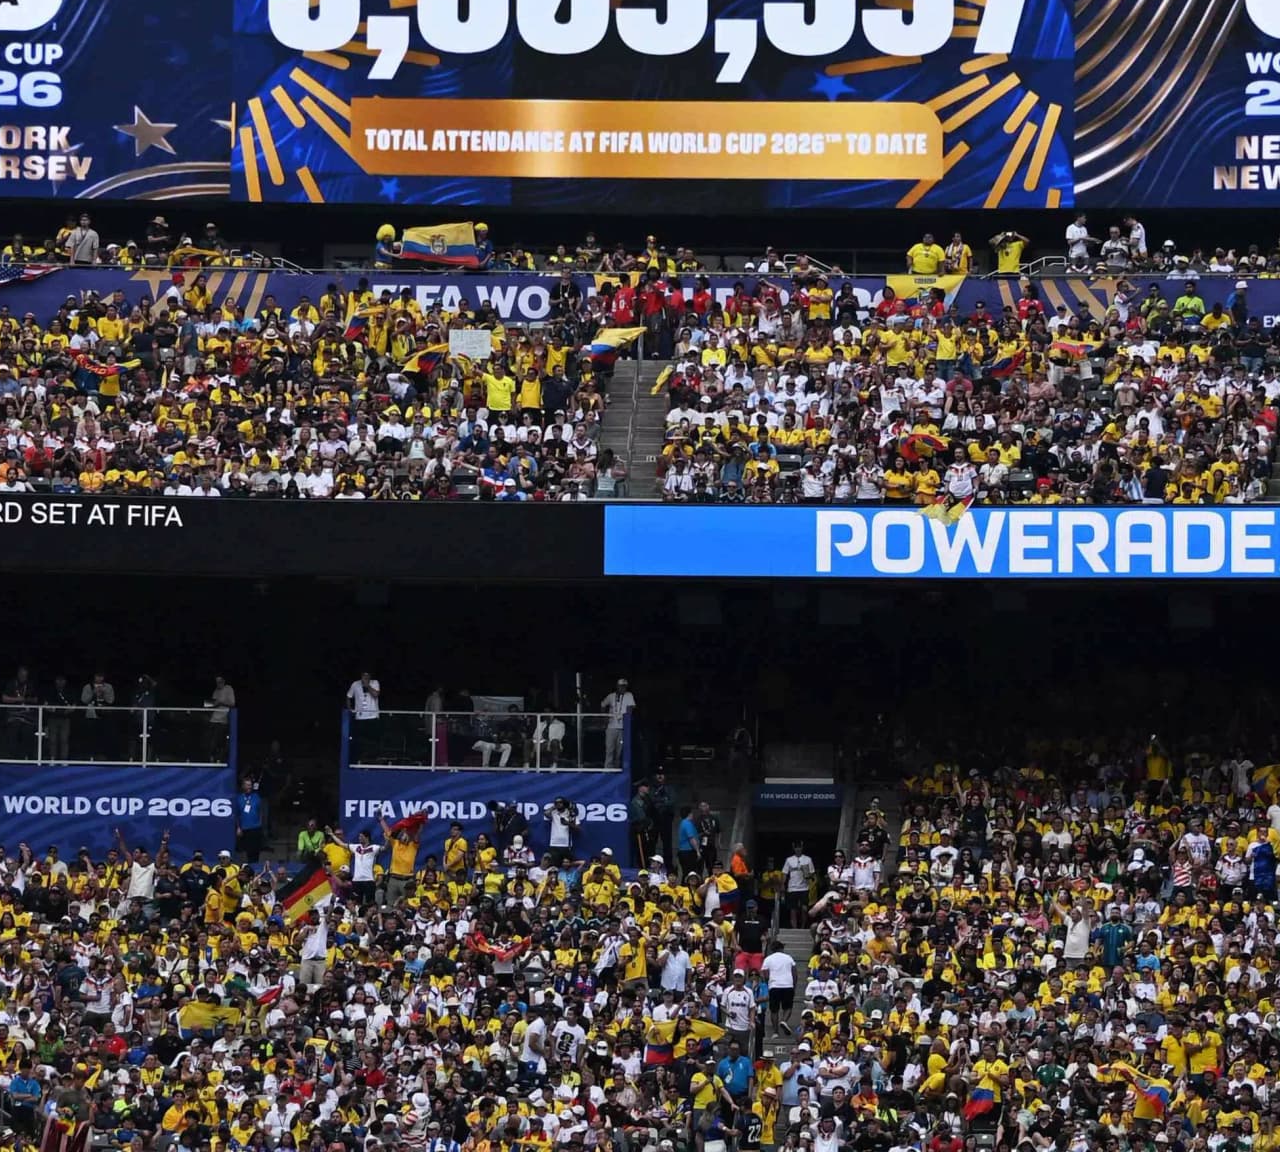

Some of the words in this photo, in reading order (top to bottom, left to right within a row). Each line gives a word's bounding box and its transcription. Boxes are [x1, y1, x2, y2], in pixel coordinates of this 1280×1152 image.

[4, 43, 64, 65] CUP
[365, 128, 428, 152] TOTAL
[432, 128, 565, 154] ATTENDANCE
[568, 131, 595, 154] AT
[599, 131, 643, 154] FIFA
[648, 132, 721, 155] WORLD
[726, 132, 766, 155] CUP
[845, 132, 871, 156] TO
[875, 132, 928, 156] DATE
[31, 503, 82, 524] SET
[87, 504, 120, 524] AT
[128, 505, 183, 527] FIFA
[4, 795, 91, 814] WORLD
[96, 797, 144, 815] CUP
[148, 798, 233, 816] 2026
[345, 799, 395, 818] FIFA
[399, 800, 487, 820] WORLD
[748, 1125, 761, 1142] 22
